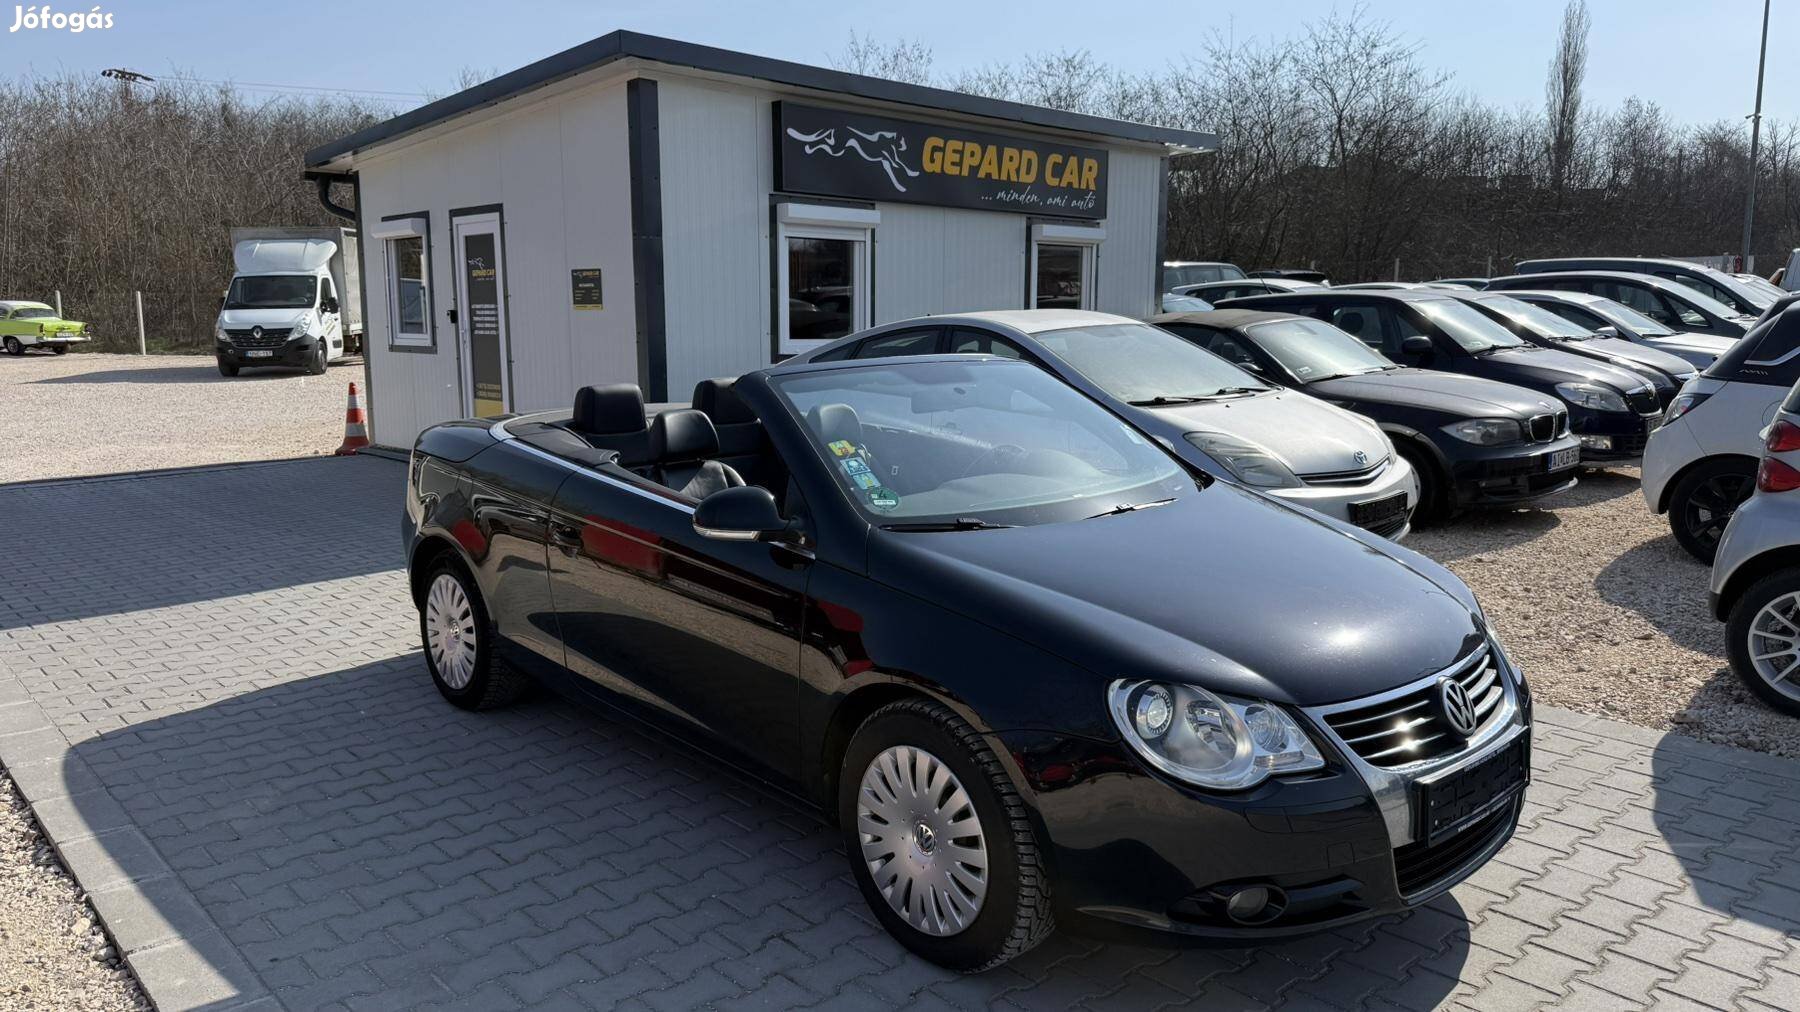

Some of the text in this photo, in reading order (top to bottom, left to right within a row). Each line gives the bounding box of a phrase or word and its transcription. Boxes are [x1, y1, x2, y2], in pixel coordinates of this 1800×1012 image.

[922, 136, 1098, 191] GEPARD CAR
[996, 185, 1043, 206] minden,
[1046, 195, 1067, 208] ami
